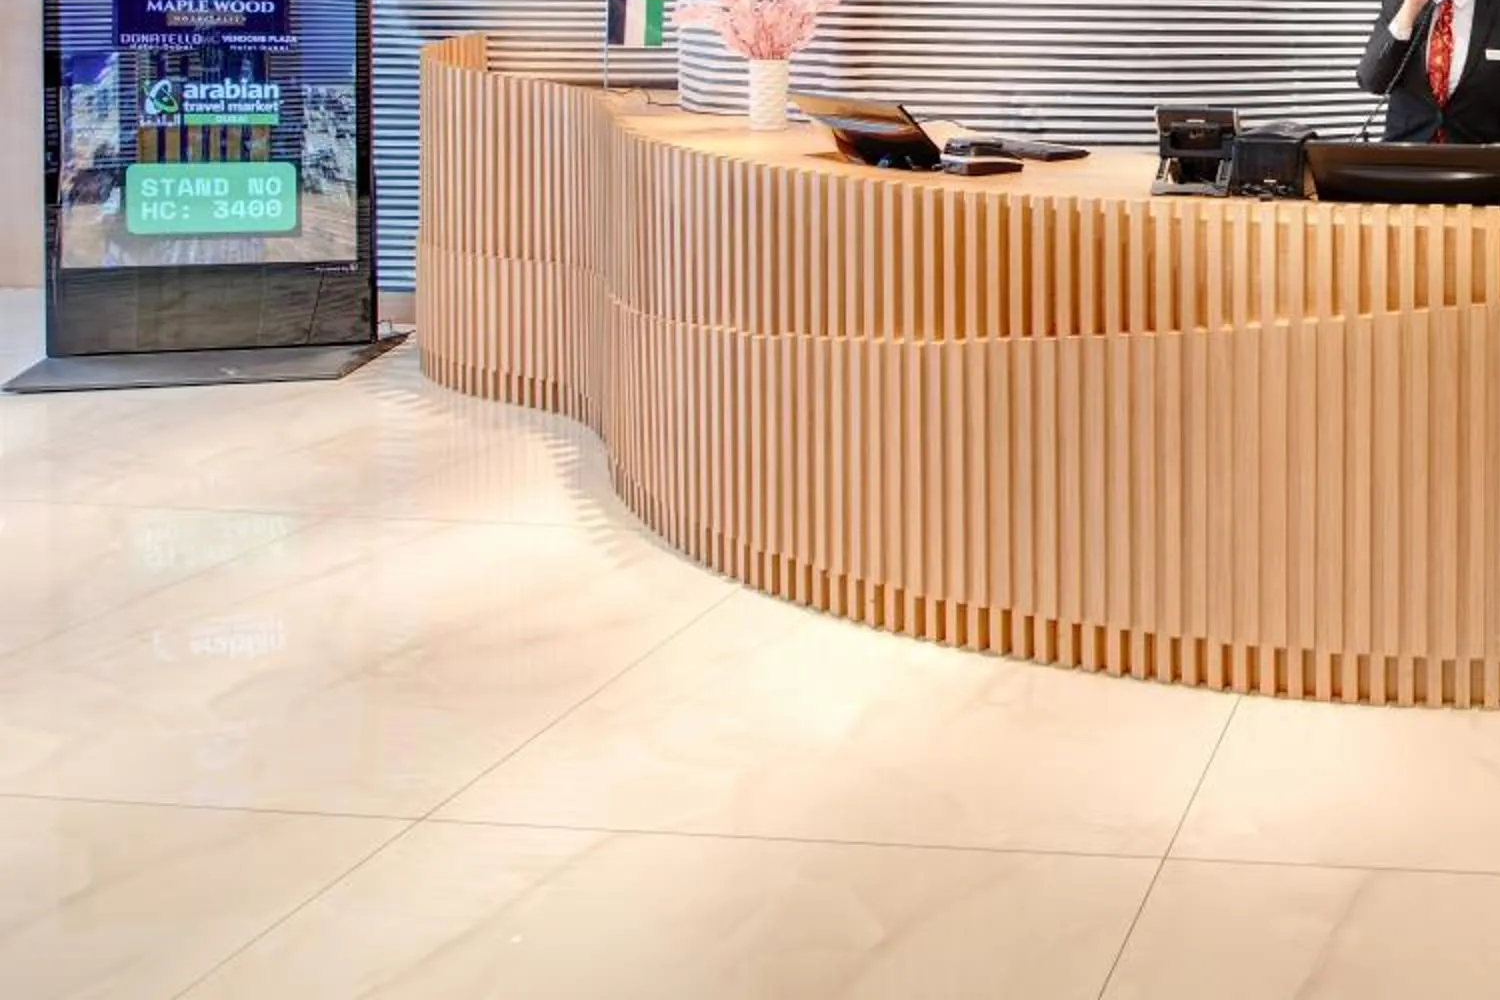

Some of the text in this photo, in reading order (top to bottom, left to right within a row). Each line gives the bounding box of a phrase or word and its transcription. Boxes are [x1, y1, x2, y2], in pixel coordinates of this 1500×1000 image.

[146, 0, 275, 13] MAPLE WOOD
[120, 33, 201, 45] DONATELLO
[183, 78, 280, 99] arabian
[183, 100, 279, 112] travel market
[141, 176, 282, 197] STAND NO
[141, 199, 282, 220] HC: 3400
